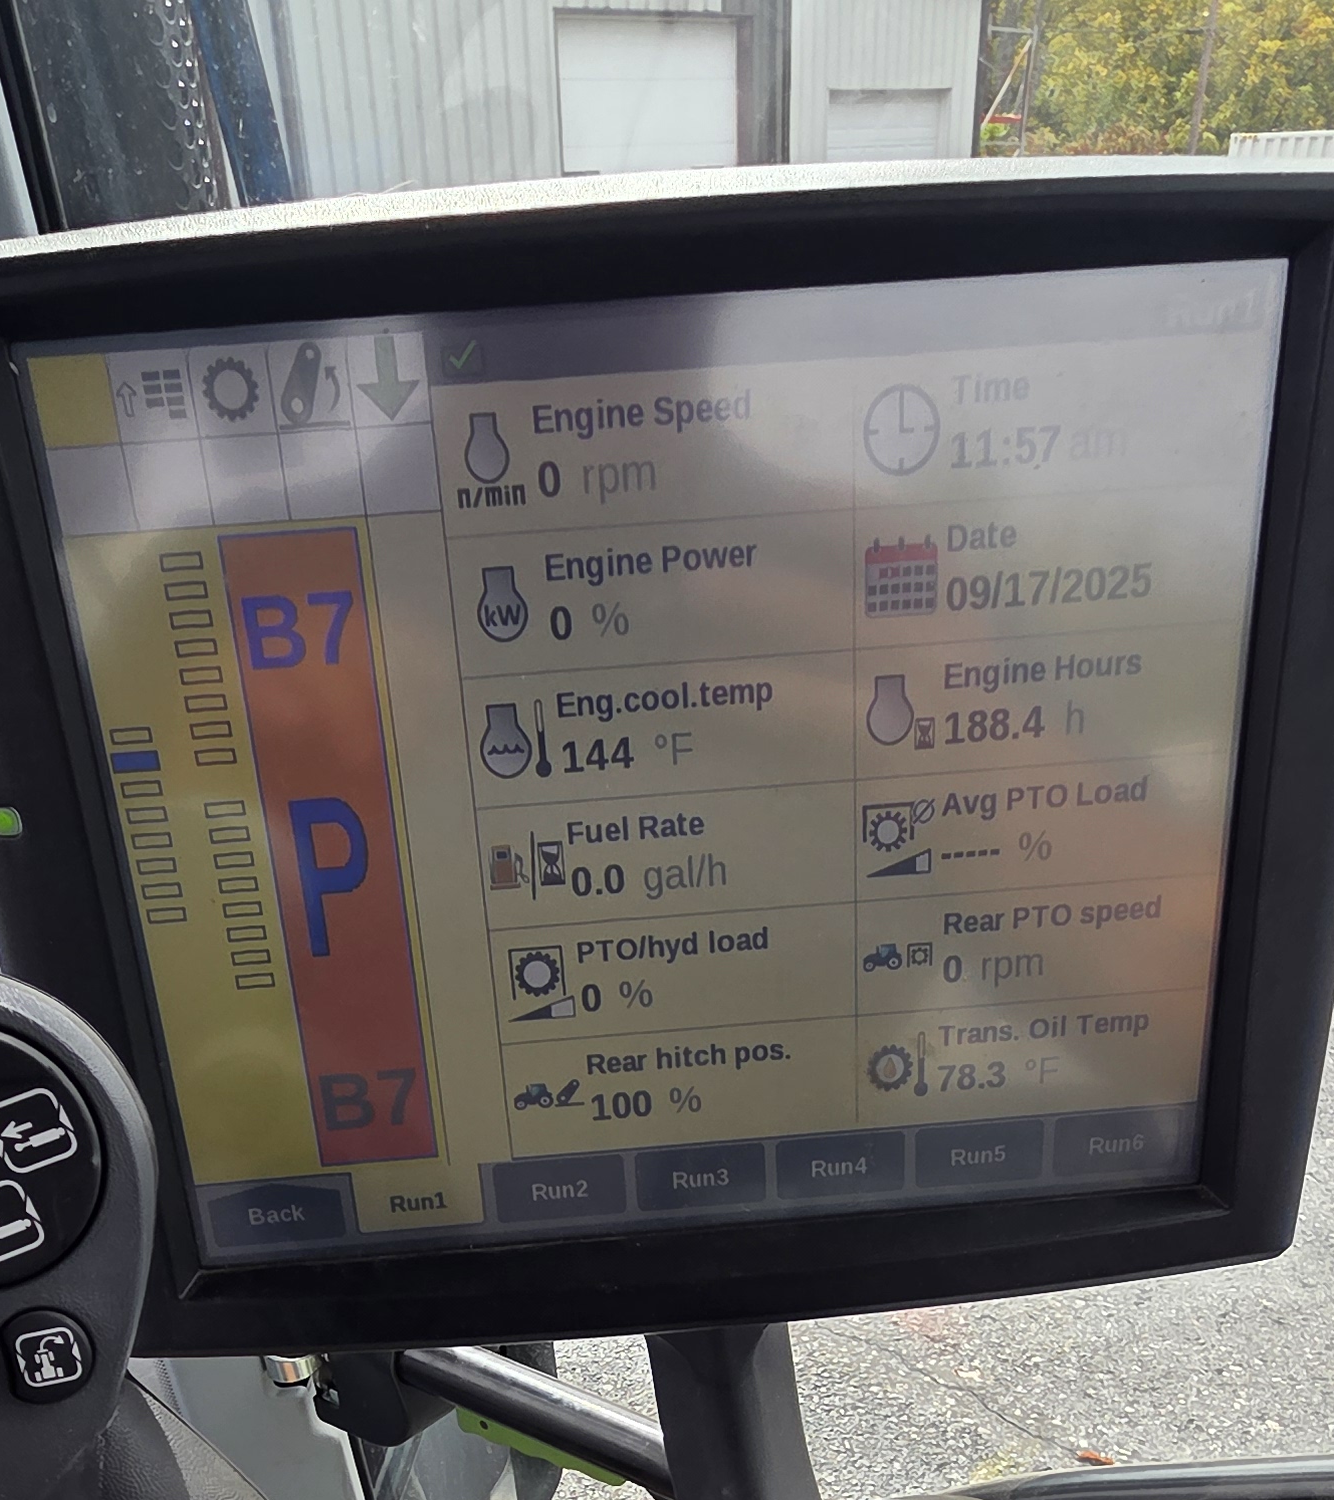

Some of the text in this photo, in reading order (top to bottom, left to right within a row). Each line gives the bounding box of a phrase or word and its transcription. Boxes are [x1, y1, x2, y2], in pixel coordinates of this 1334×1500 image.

[951, 373, 1030, 405] Time
[532, 388, 752, 439] Engine Speed
[949, 425, 1062, 469] 11:57
[457, 484, 526, 509] n/min
[537, 459, 657, 505] 0 rpm
[946, 521, 1017, 553] Date
[544, 542, 757, 586] Engine Power
[946, 562, 1153, 612] 09/17/2025
[240, 589, 354, 671] B7
[484, 603, 521, 628] kW
[550, 601, 629, 640] 0 %
[944, 652, 1143, 693] Engine Hours
[557, 680, 774, 722] Eng.cool.temp
[944, 700, 1085, 745] 188.4 h
[562, 732, 693, 774] 144 °F
[942, 774, 1150, 821] Avg PTO Load
[567, 812, 705, 845] Fuel Rate
[1018, 829, 1053, 862] %
[288, 796, 369, 957] P
[571, 852, 727, 900] 0.0 gal/h
[943, 894, 1163, 935] Rear PTO speed
[576, 926, 769, 964] PTO/hyd load
[942, 952, 1044, 988] 0 rpm
[581, 979, 654, 1012] 0 %
[938, 1011, 1150, 1047] Trans. Oil Temp
[586, 1042, 792, 1076] Rear hitch pos.
[936, 1055, 1061, 1093] 78.3 °F
[317, 1067, 417, 1132] B7
[591, 1085, 703, 1121] 100 %
[950, 1144, 1007, 1167] Run5
[1088, 1133, 1145, 1156] Run6
[672, 1168, 730, 1190] Run3
[810, 1156, 869, 1179] Run4
[389, 1191, 449, 1215] Run1
[531, 1179, 589, 1202] Run2
[247, 1204, 306, 1226] Back
